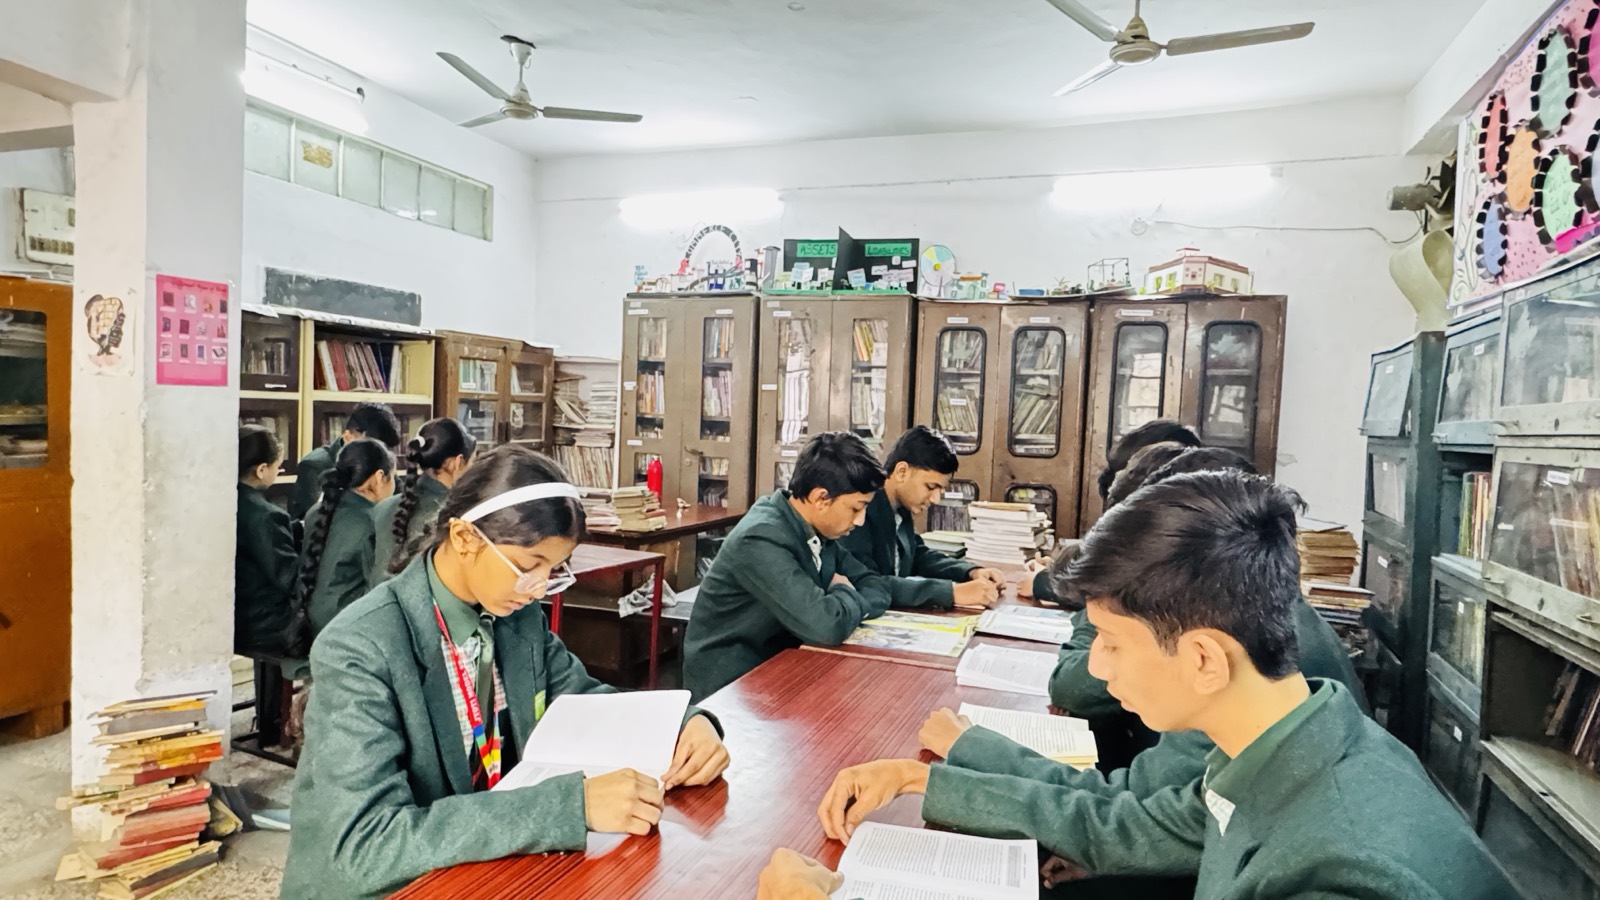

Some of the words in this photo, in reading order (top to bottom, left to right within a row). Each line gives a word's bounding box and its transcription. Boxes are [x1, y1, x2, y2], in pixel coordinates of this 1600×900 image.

[801, 244, 836, 256] ASSETS
[462, 670, 476, 699] MODEL
[470, 699, 482, 721] JYOTI
